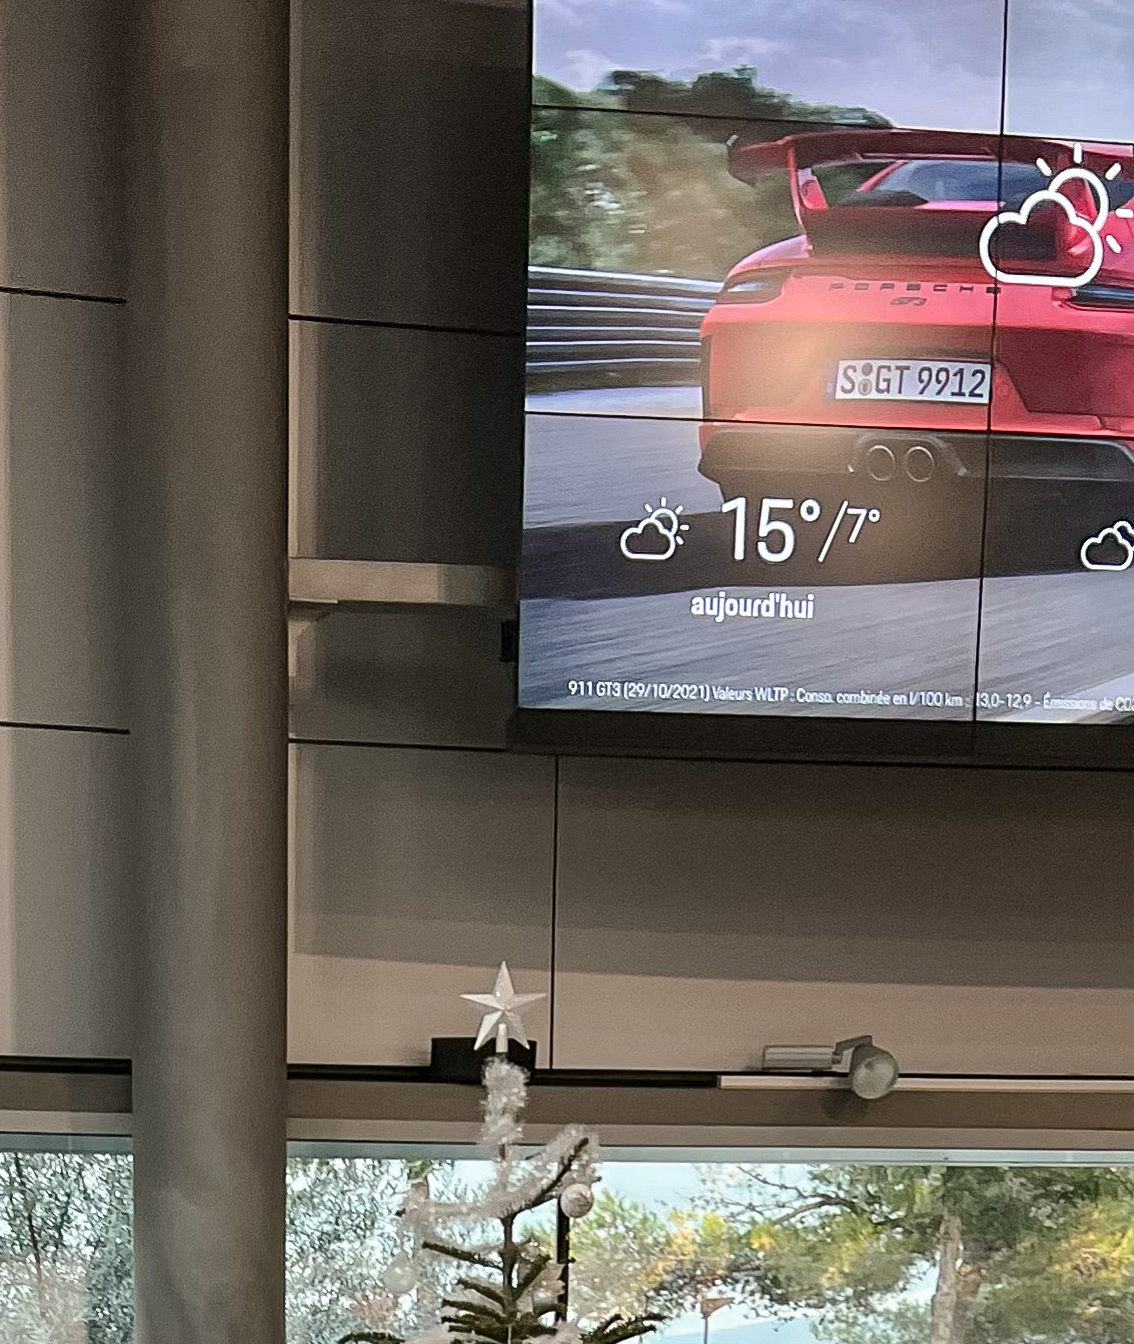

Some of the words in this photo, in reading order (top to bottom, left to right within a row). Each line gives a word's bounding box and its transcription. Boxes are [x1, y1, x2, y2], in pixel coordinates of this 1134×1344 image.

[918, 366, 986, 398] 9912
[690, 591, 815, 622] aujourd'hui
[568, 680, 593, 697] 911
[596, 682, 621, 697] GT3
[623, 681, 710, 702] (29/10/2021)
[712, 685, 753, 701] Valeurs
[754, 687, 789, 702] WLTP
[836, 690, 890, 705] combinée
[892, 693, 907, 705] en
[944, 691, 964, 707] km
